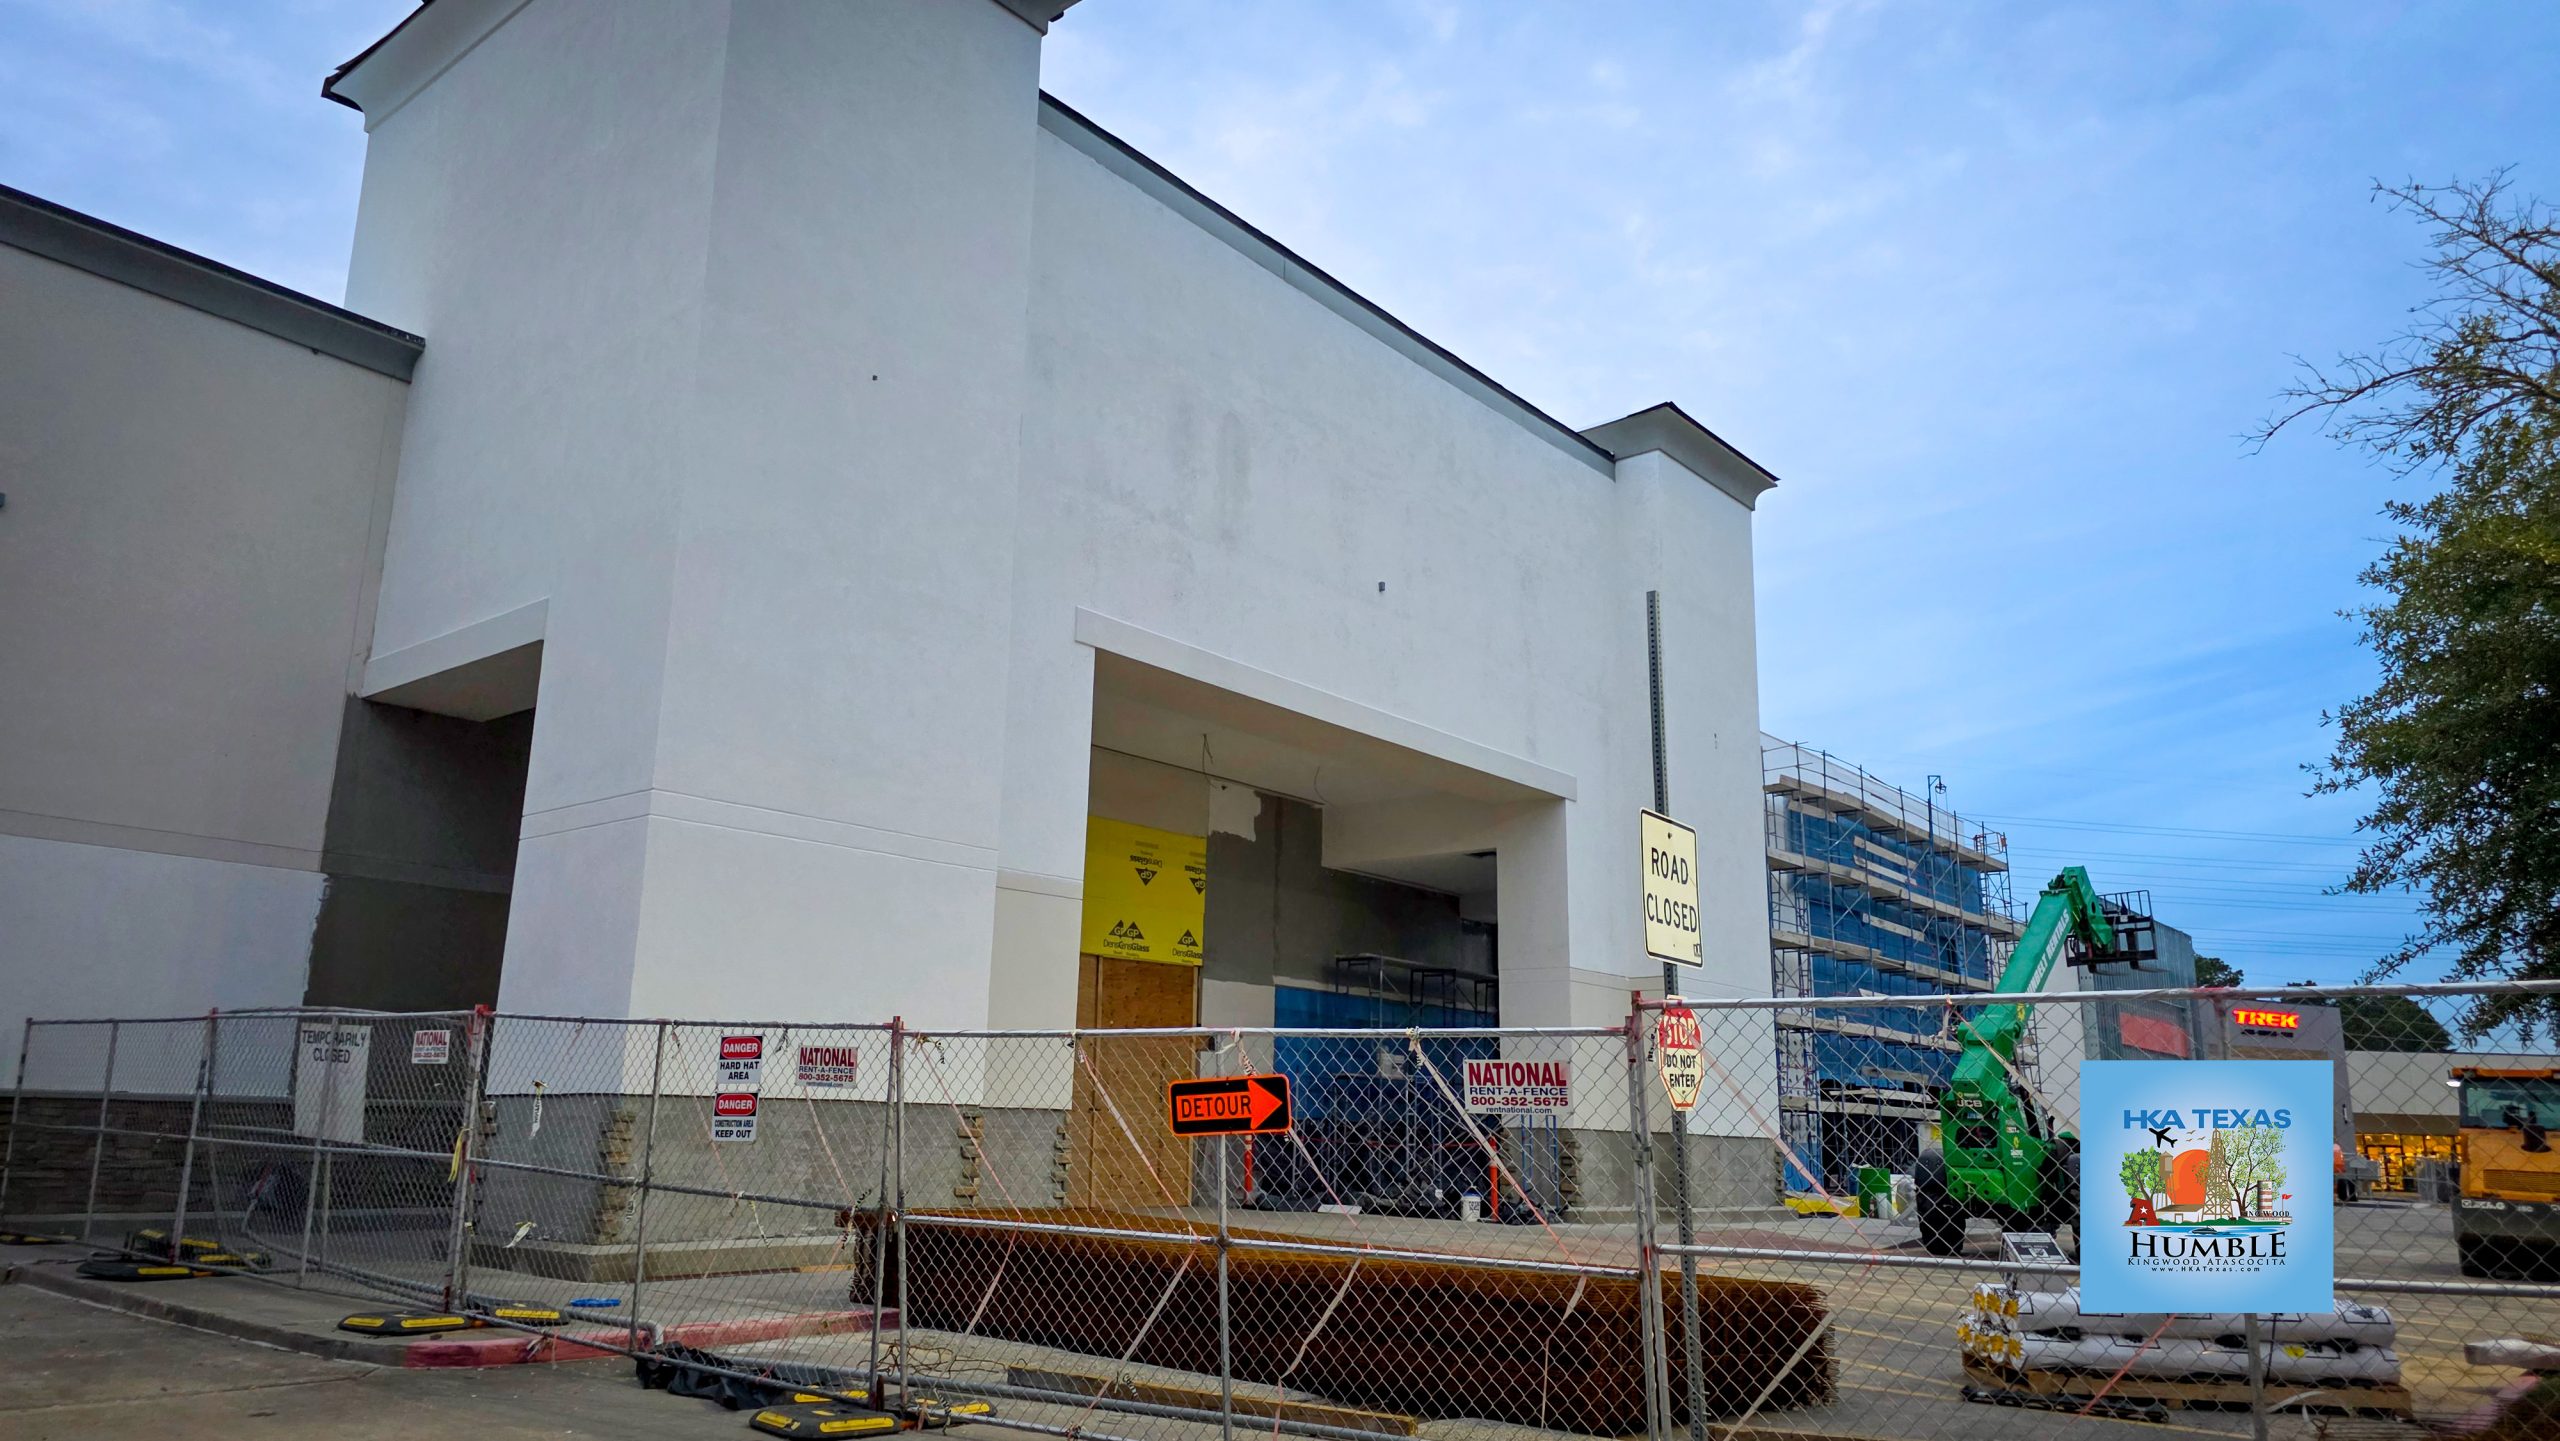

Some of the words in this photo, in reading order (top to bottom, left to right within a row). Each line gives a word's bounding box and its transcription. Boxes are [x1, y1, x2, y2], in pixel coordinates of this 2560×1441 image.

[1651, 847, 1689, 885] ROAD
[1646, 893, 1697, 933] CLOSED
[2233, 1010, 2299, 1029] TREK
[1663, 1015, 1696, 1046] STOP
[415, 1031, 448, 1046] NATIONAL
[723, 1043, 758, 1053] DANGER
[799, 1047, 854, 1067] NATIONAL
[1666, 1055, 1678, 1068] DO
[1680, 1055, 1697, 1069] NOT
[720, 1062, 741, 1070] HARD
[743, 1061, 760, 1070] HAT
[798, 1066, 854, 1074] RENT-A-FENCE
[728, 1072, 749, 1080] AREA
[798, 1073, 854, 1082] 800-352-5675
[1468, 1062, 1567, 1087] NATIONAL
[1669, 1073, 1696, 1088] ENTER
[1469, 1087, 1568, 1096] RENT-A-FENCE
[718, 1099, 753, 1110] DANGER
[1181, 1095, 1252, 1118] DETOUR
[1471, 1096, 1569, 1106] 800-352-5675
[1957, 1099, 1983, 1108] JCB
[715, 1130, 734, 1138] KEEP
[736, 1130, 751, 1138] OUT
